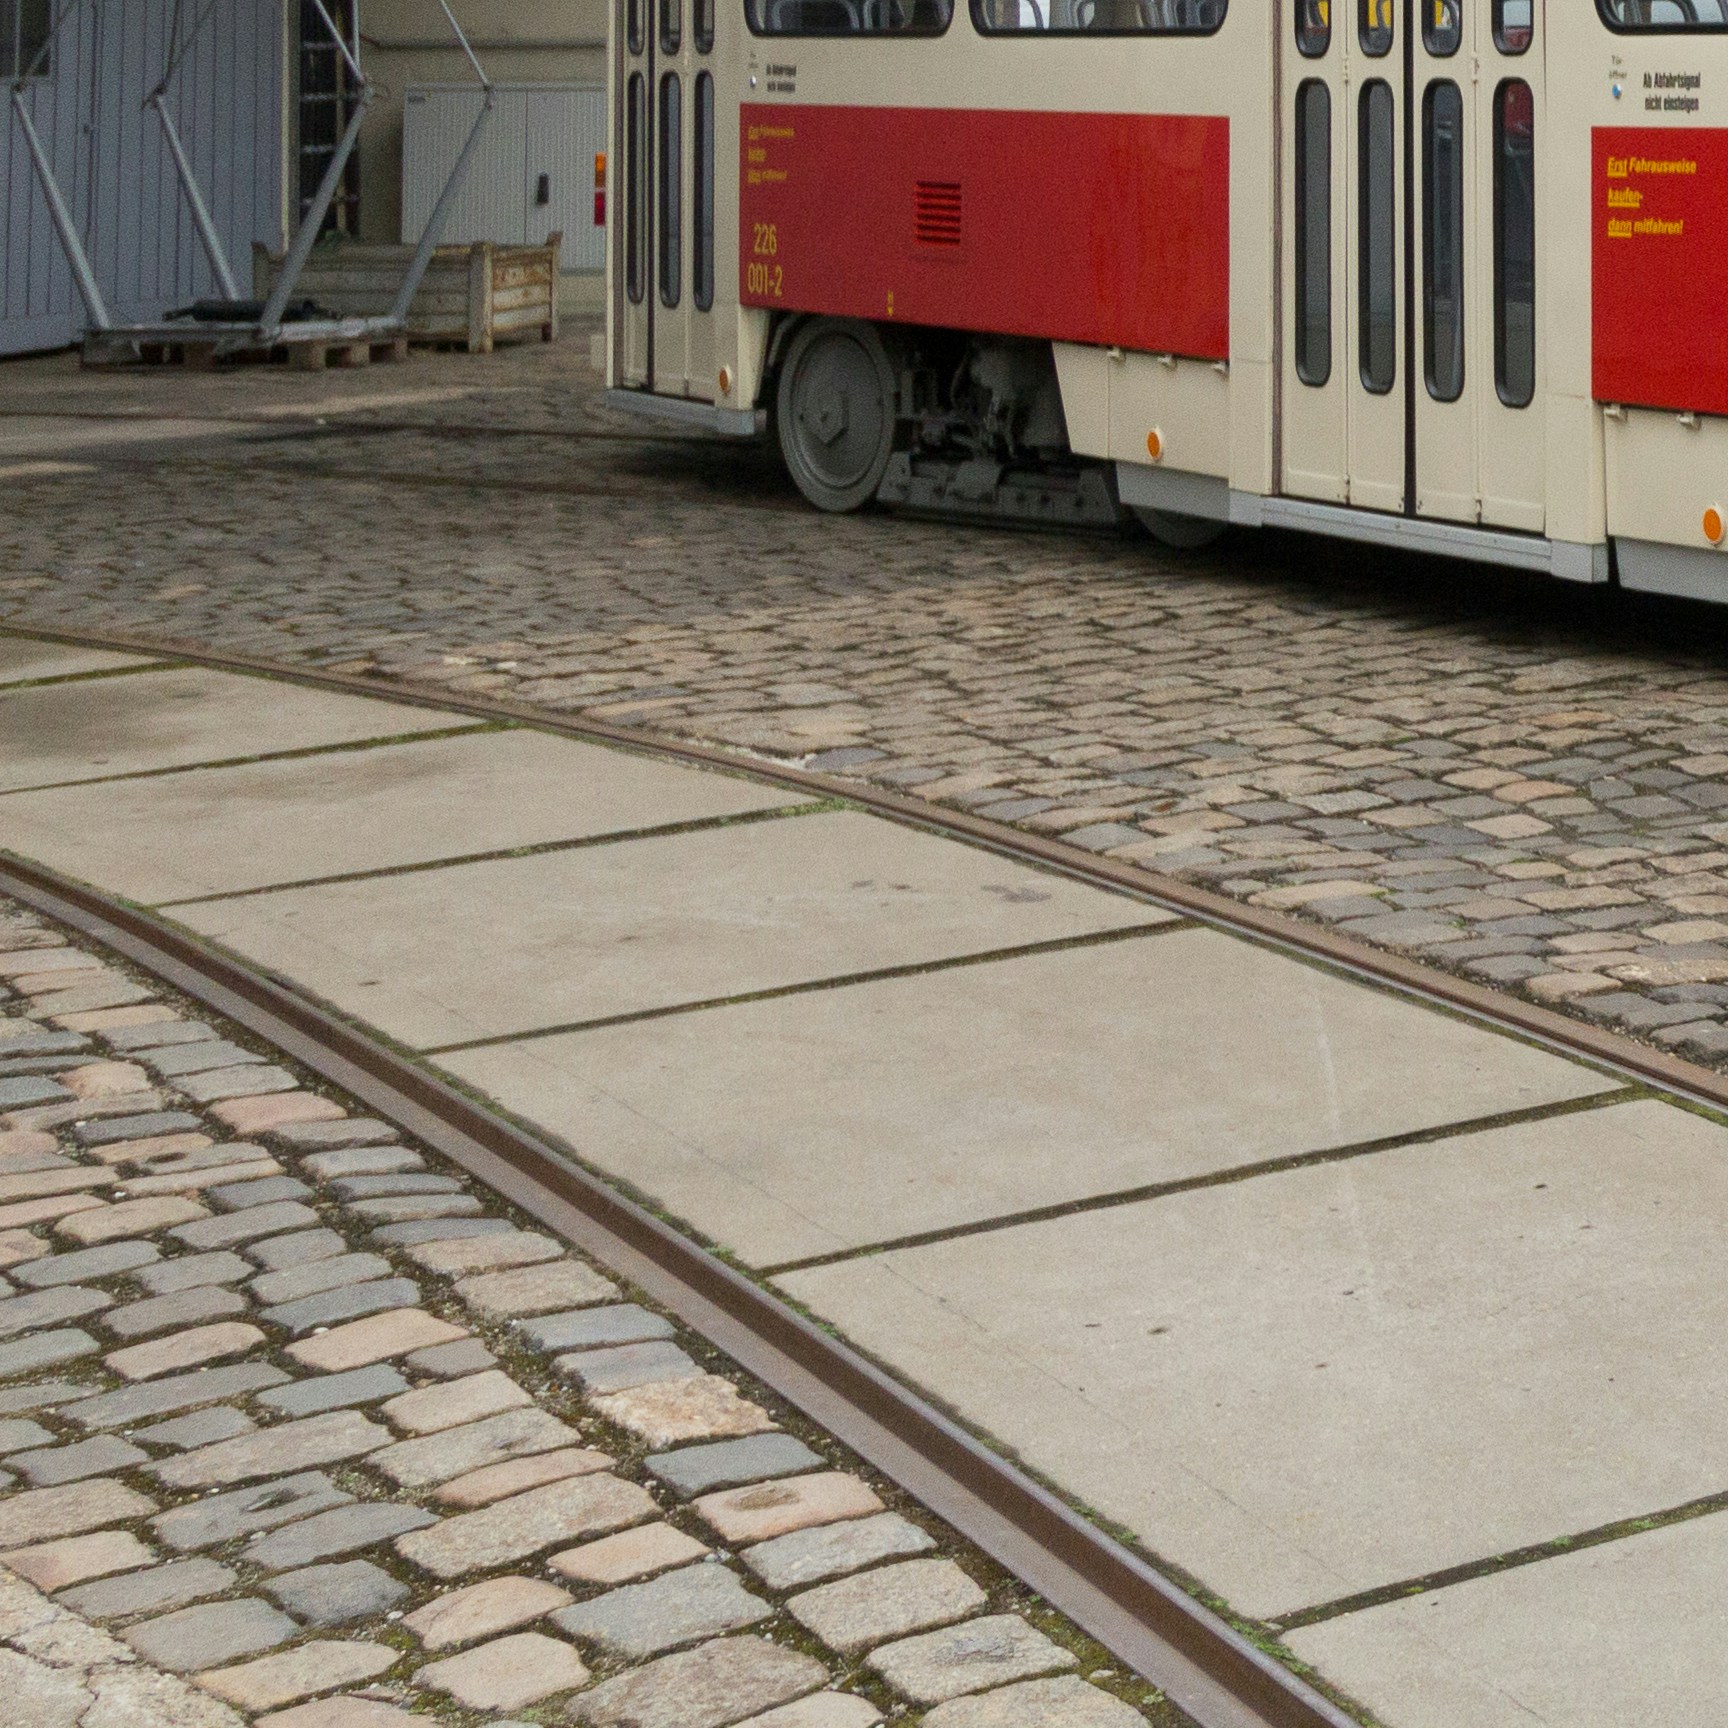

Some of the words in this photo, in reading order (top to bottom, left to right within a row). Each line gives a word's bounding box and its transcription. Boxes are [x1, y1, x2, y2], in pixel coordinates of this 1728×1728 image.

[1629, 157, 1697, 174] Fahrausweise
[754, 223, 777, 255] 226
[1608, 219, 1633, 236] dann
[748, 262, 783, 297] 001-2
